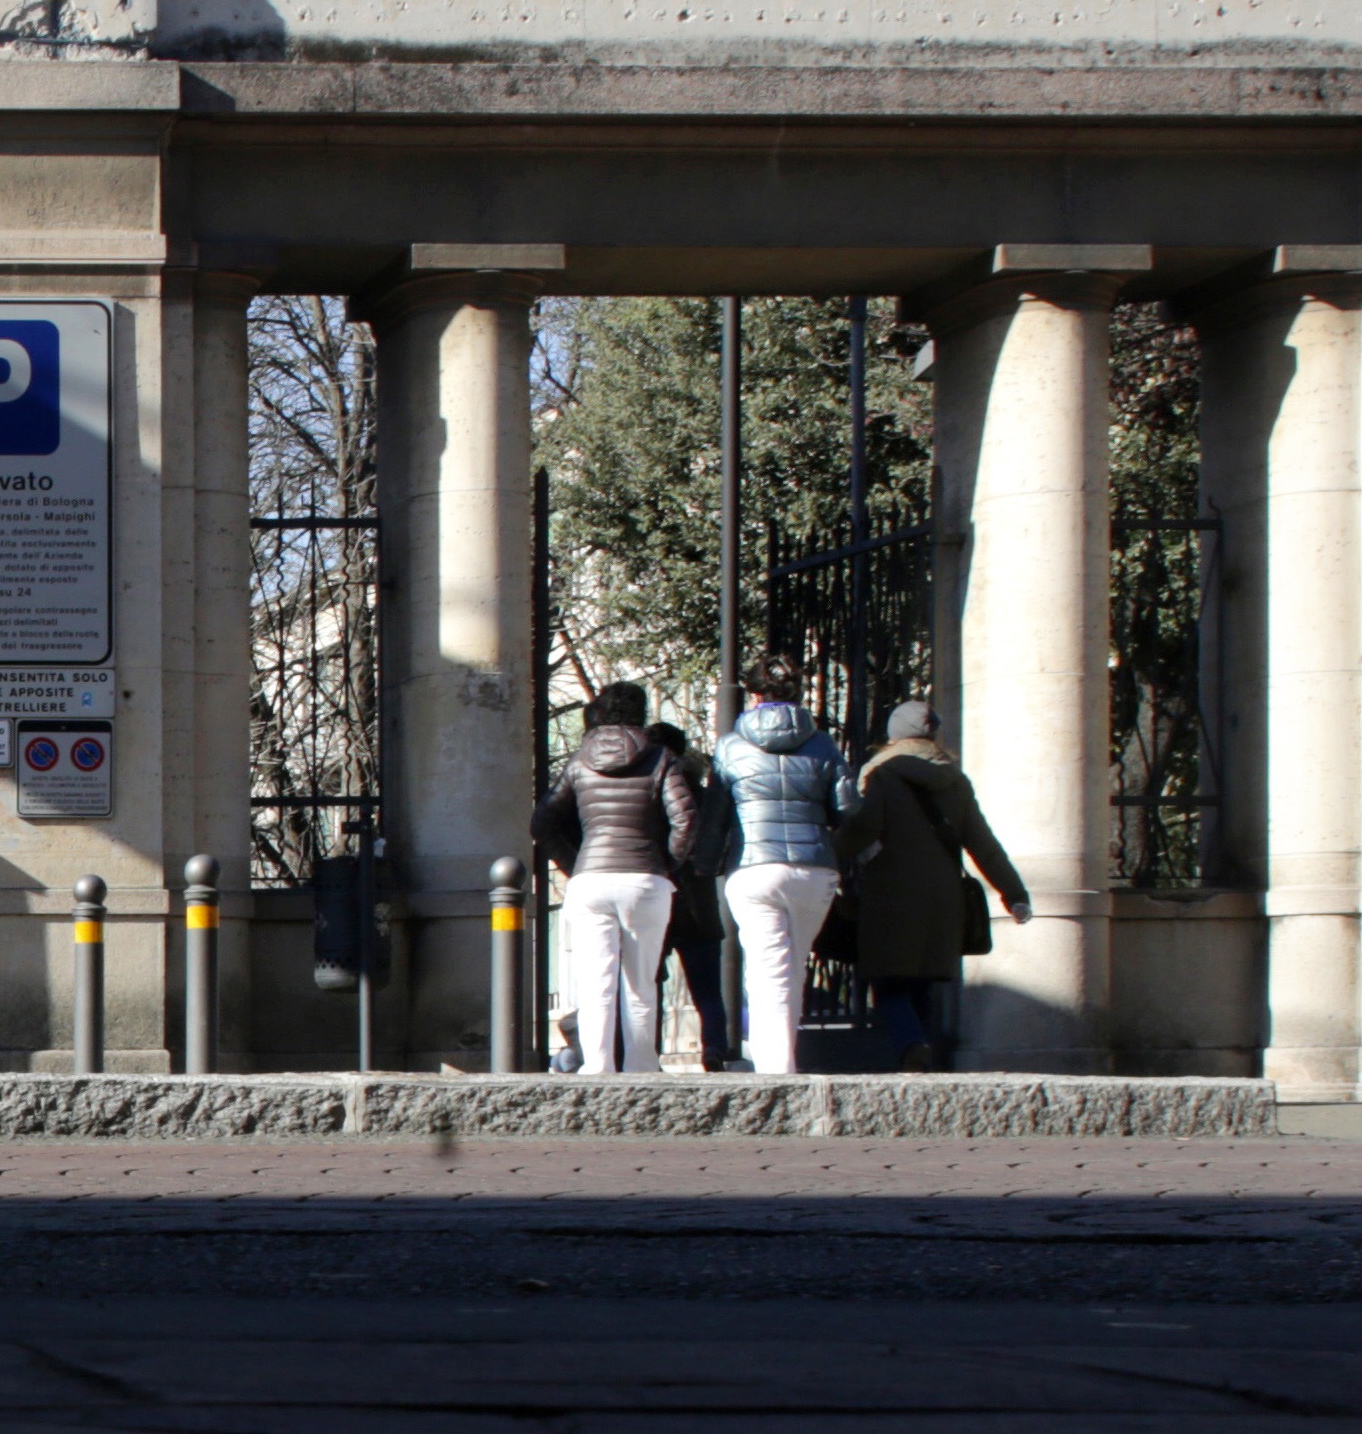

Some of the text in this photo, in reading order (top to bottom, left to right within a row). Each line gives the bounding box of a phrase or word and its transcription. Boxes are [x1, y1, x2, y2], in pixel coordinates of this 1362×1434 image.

[27, 497, 38, 506] di
[42, 496, 94, 508] Bologna
[43, 512, 95, 523] Malpighi
[17, 587, 32, 597] 24
[72, 672, 108, 683] SOLO
[9, 687, 74, 697] APPOSITE
